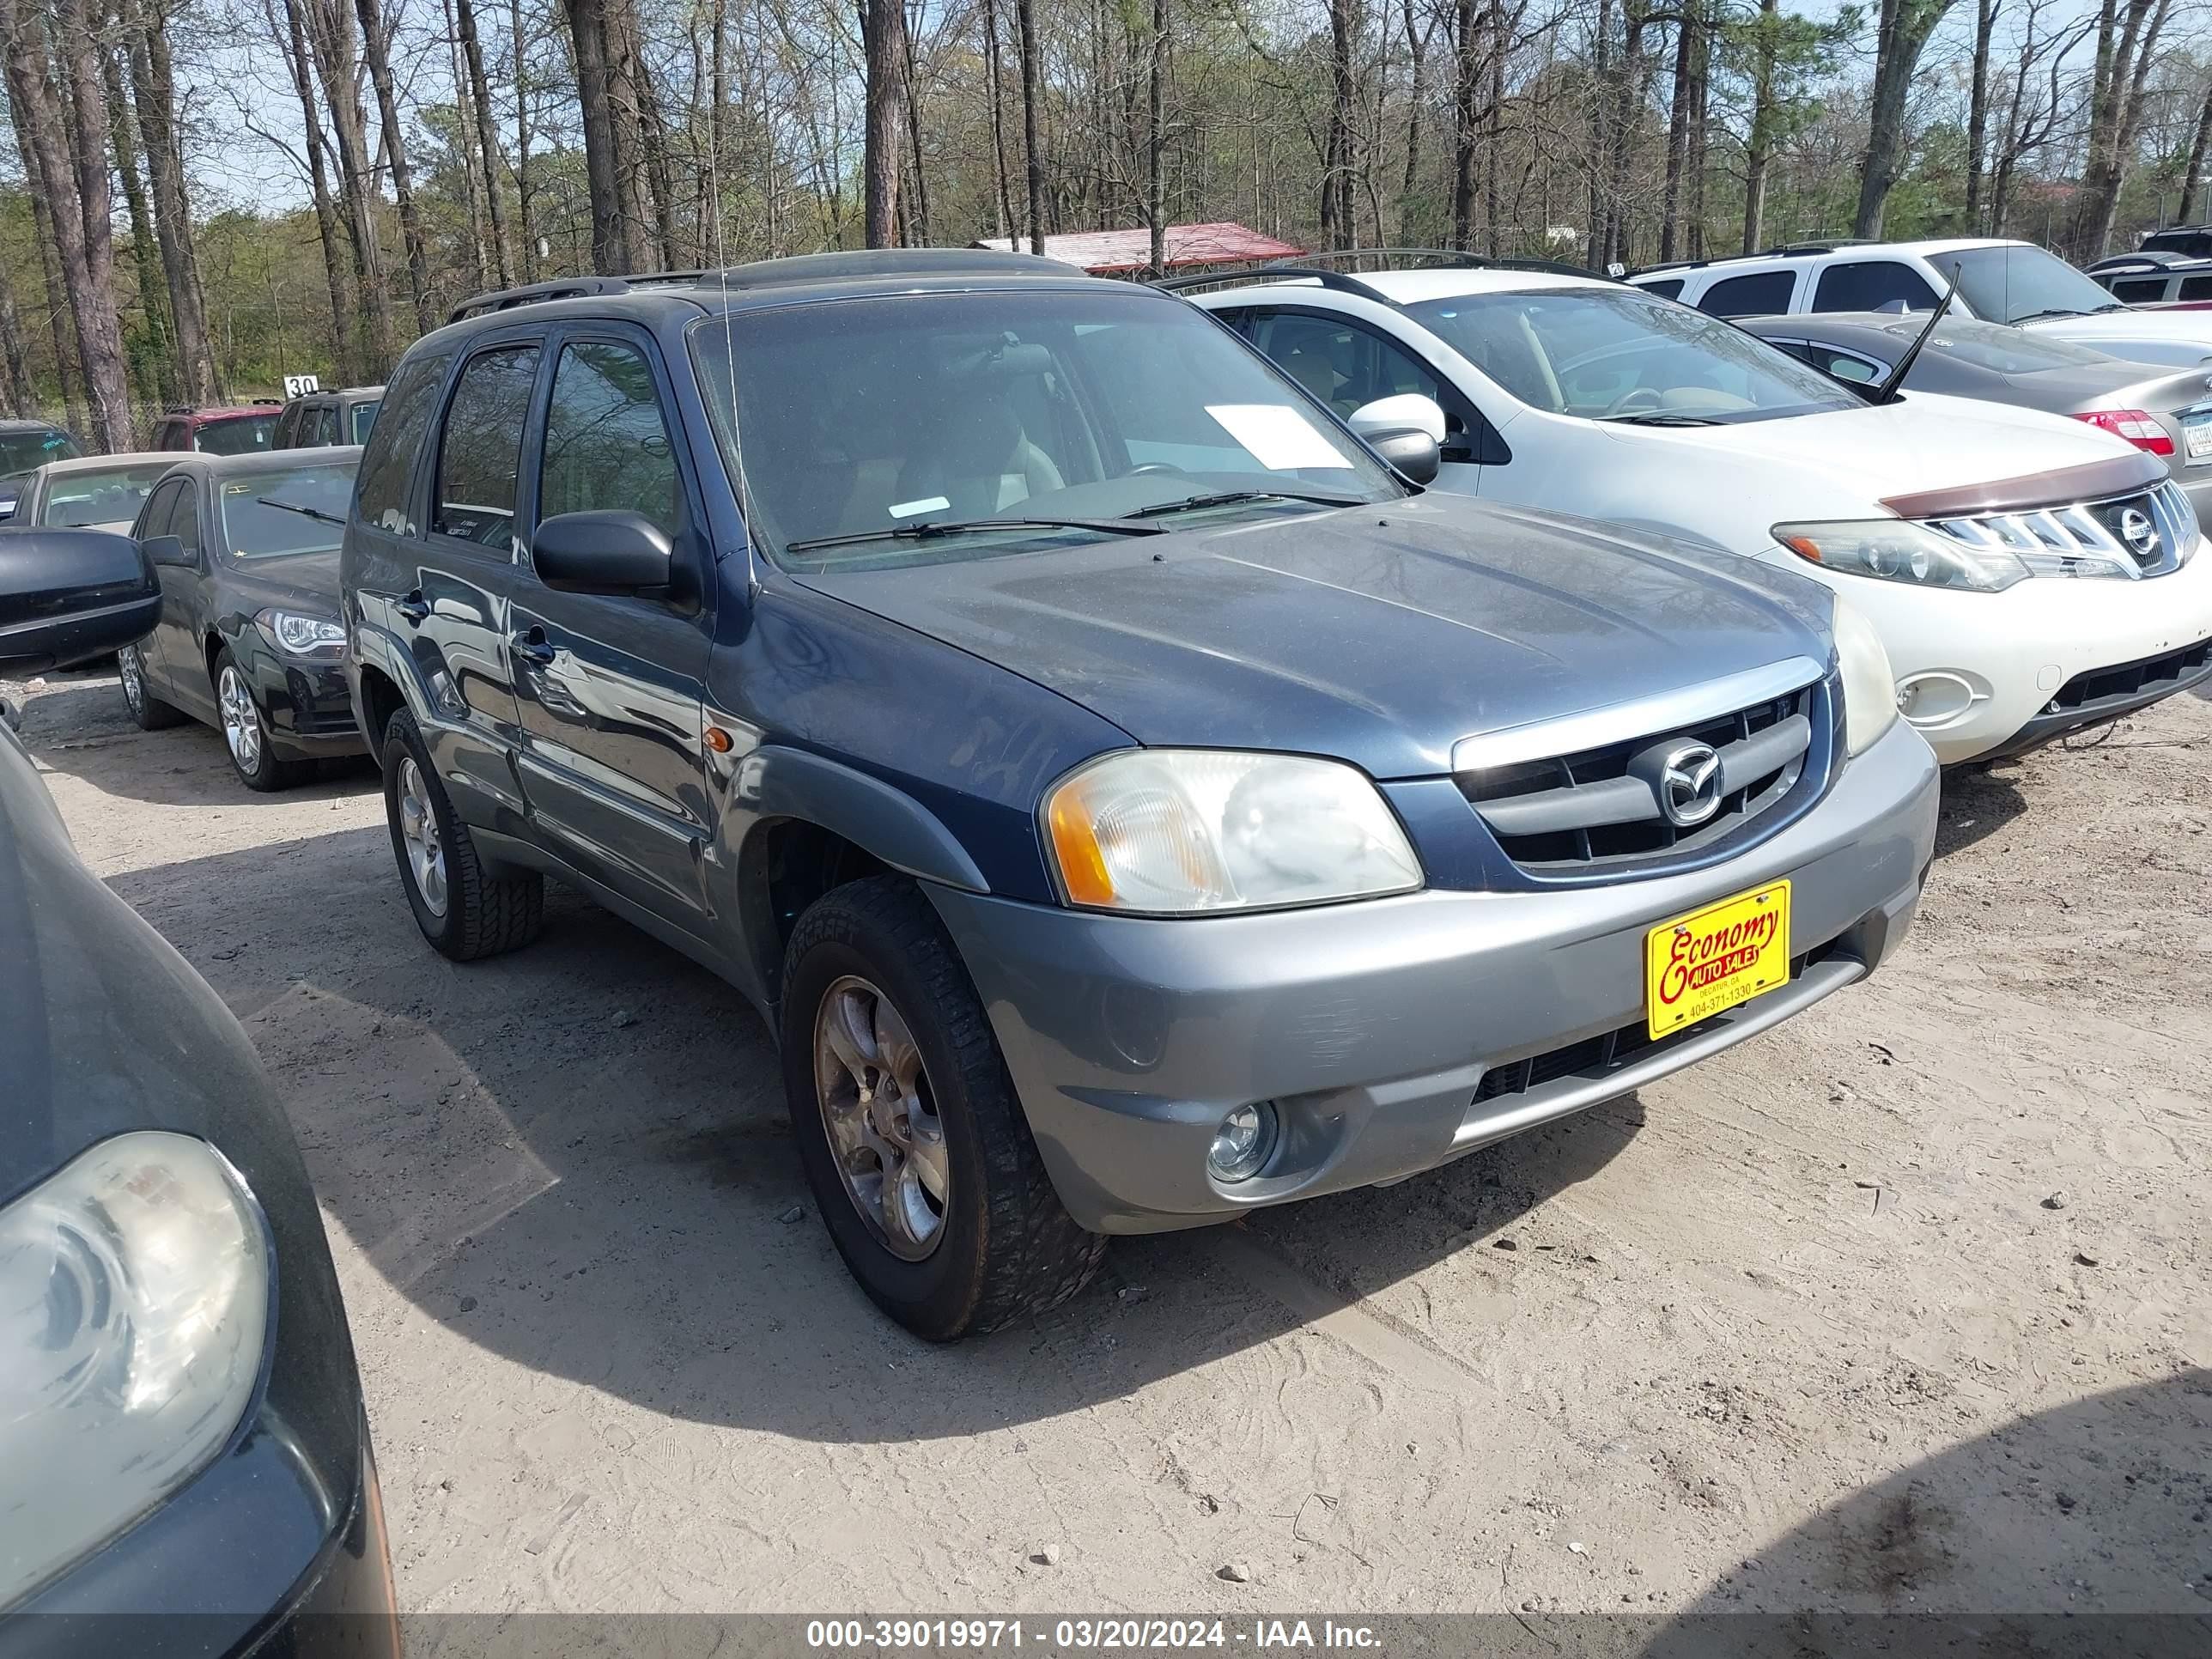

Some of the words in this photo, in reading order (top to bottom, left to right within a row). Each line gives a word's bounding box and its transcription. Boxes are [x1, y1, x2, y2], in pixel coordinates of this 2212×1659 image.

[289, 378, 314, 396] 30
[1660, 909, 1778, 1004] Economy
[1691, 960, 1722, 990] AUTO
[1723, 945, 1759, 975] SALES
[1730, 975, 1740, 986] GA
[1689, 982, 1752, 1018] 404-371-1330
